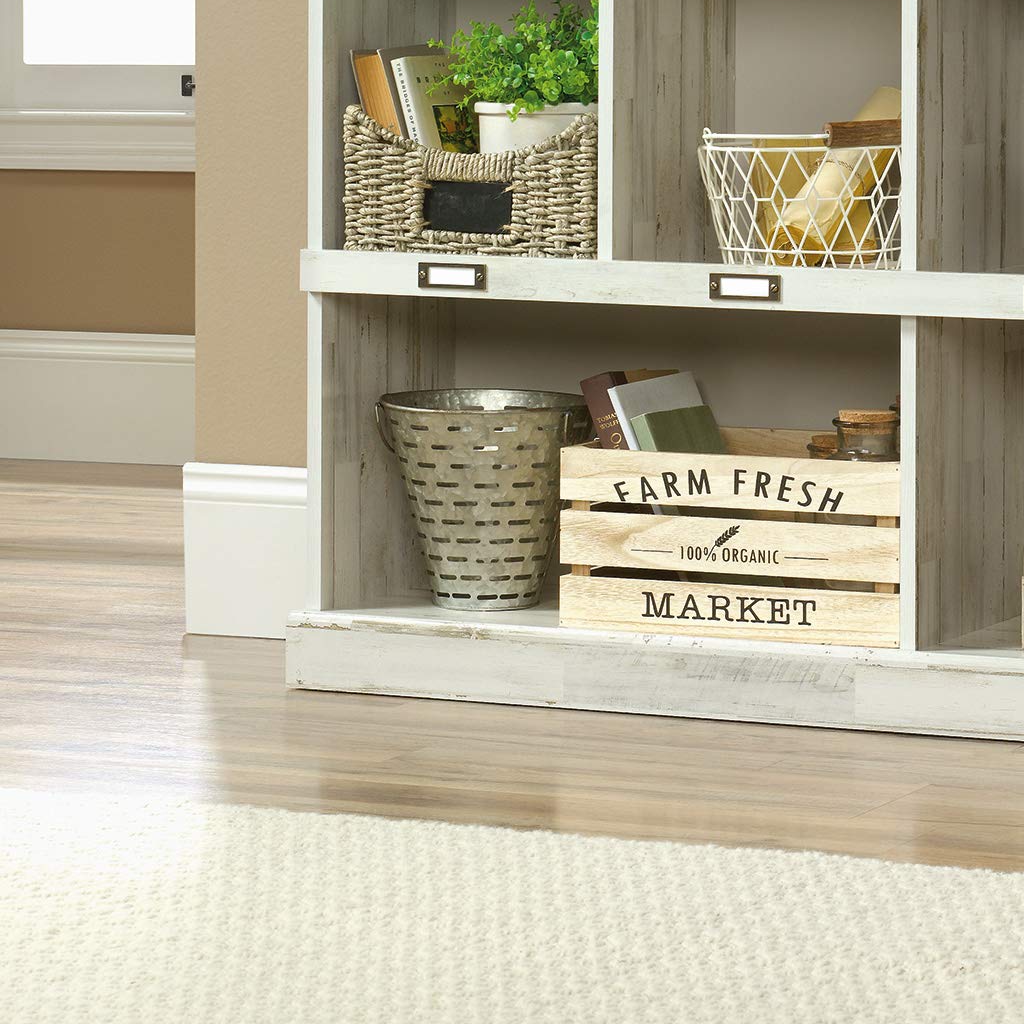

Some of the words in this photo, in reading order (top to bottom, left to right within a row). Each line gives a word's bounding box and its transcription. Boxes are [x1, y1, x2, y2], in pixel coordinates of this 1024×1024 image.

[400, 79, 411, 113] BRIDGES
[613, 468, 712, 502] FARM
[733, 469, 845, 512] FRESH
[679, 544, 717, 563] 100%
[722, 547, 780, 565] ORGANIC
[641, 591, 817, 626] MARKET
